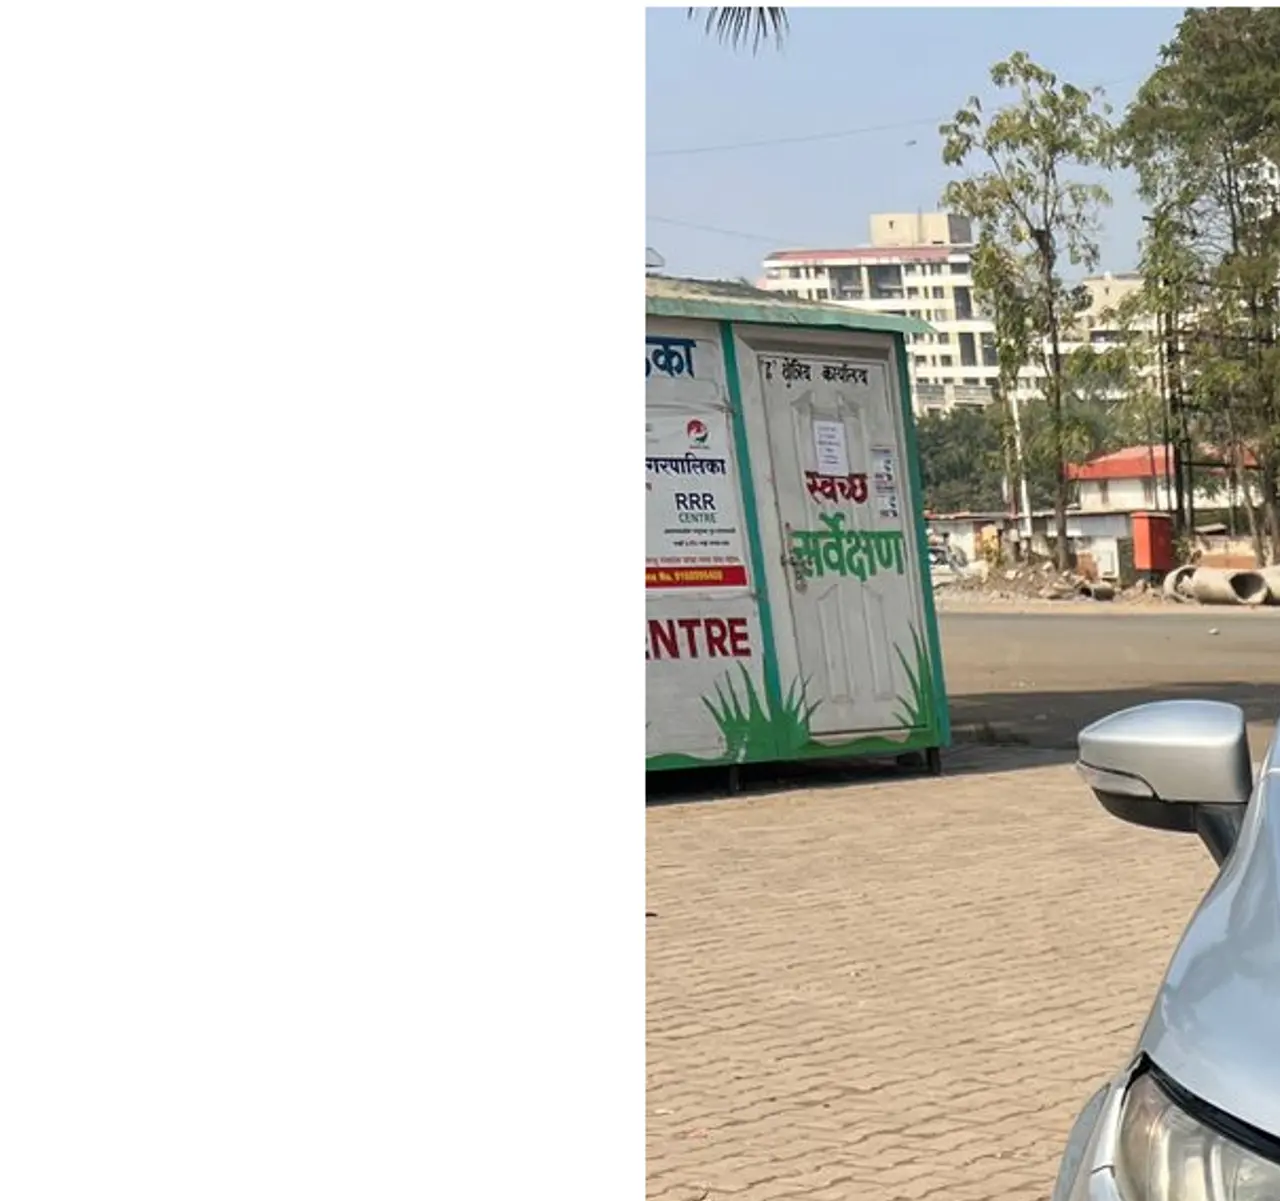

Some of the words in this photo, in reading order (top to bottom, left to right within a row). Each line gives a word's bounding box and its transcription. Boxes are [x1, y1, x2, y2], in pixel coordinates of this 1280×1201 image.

[646, 336, 697, 378] का
[674, 492, 716, 511] RRR
[804, 470, 868, 504] स्वच्छ
[678, 512, 716, 524] CENTRE
[646, 617, 751, 659] NTRE
